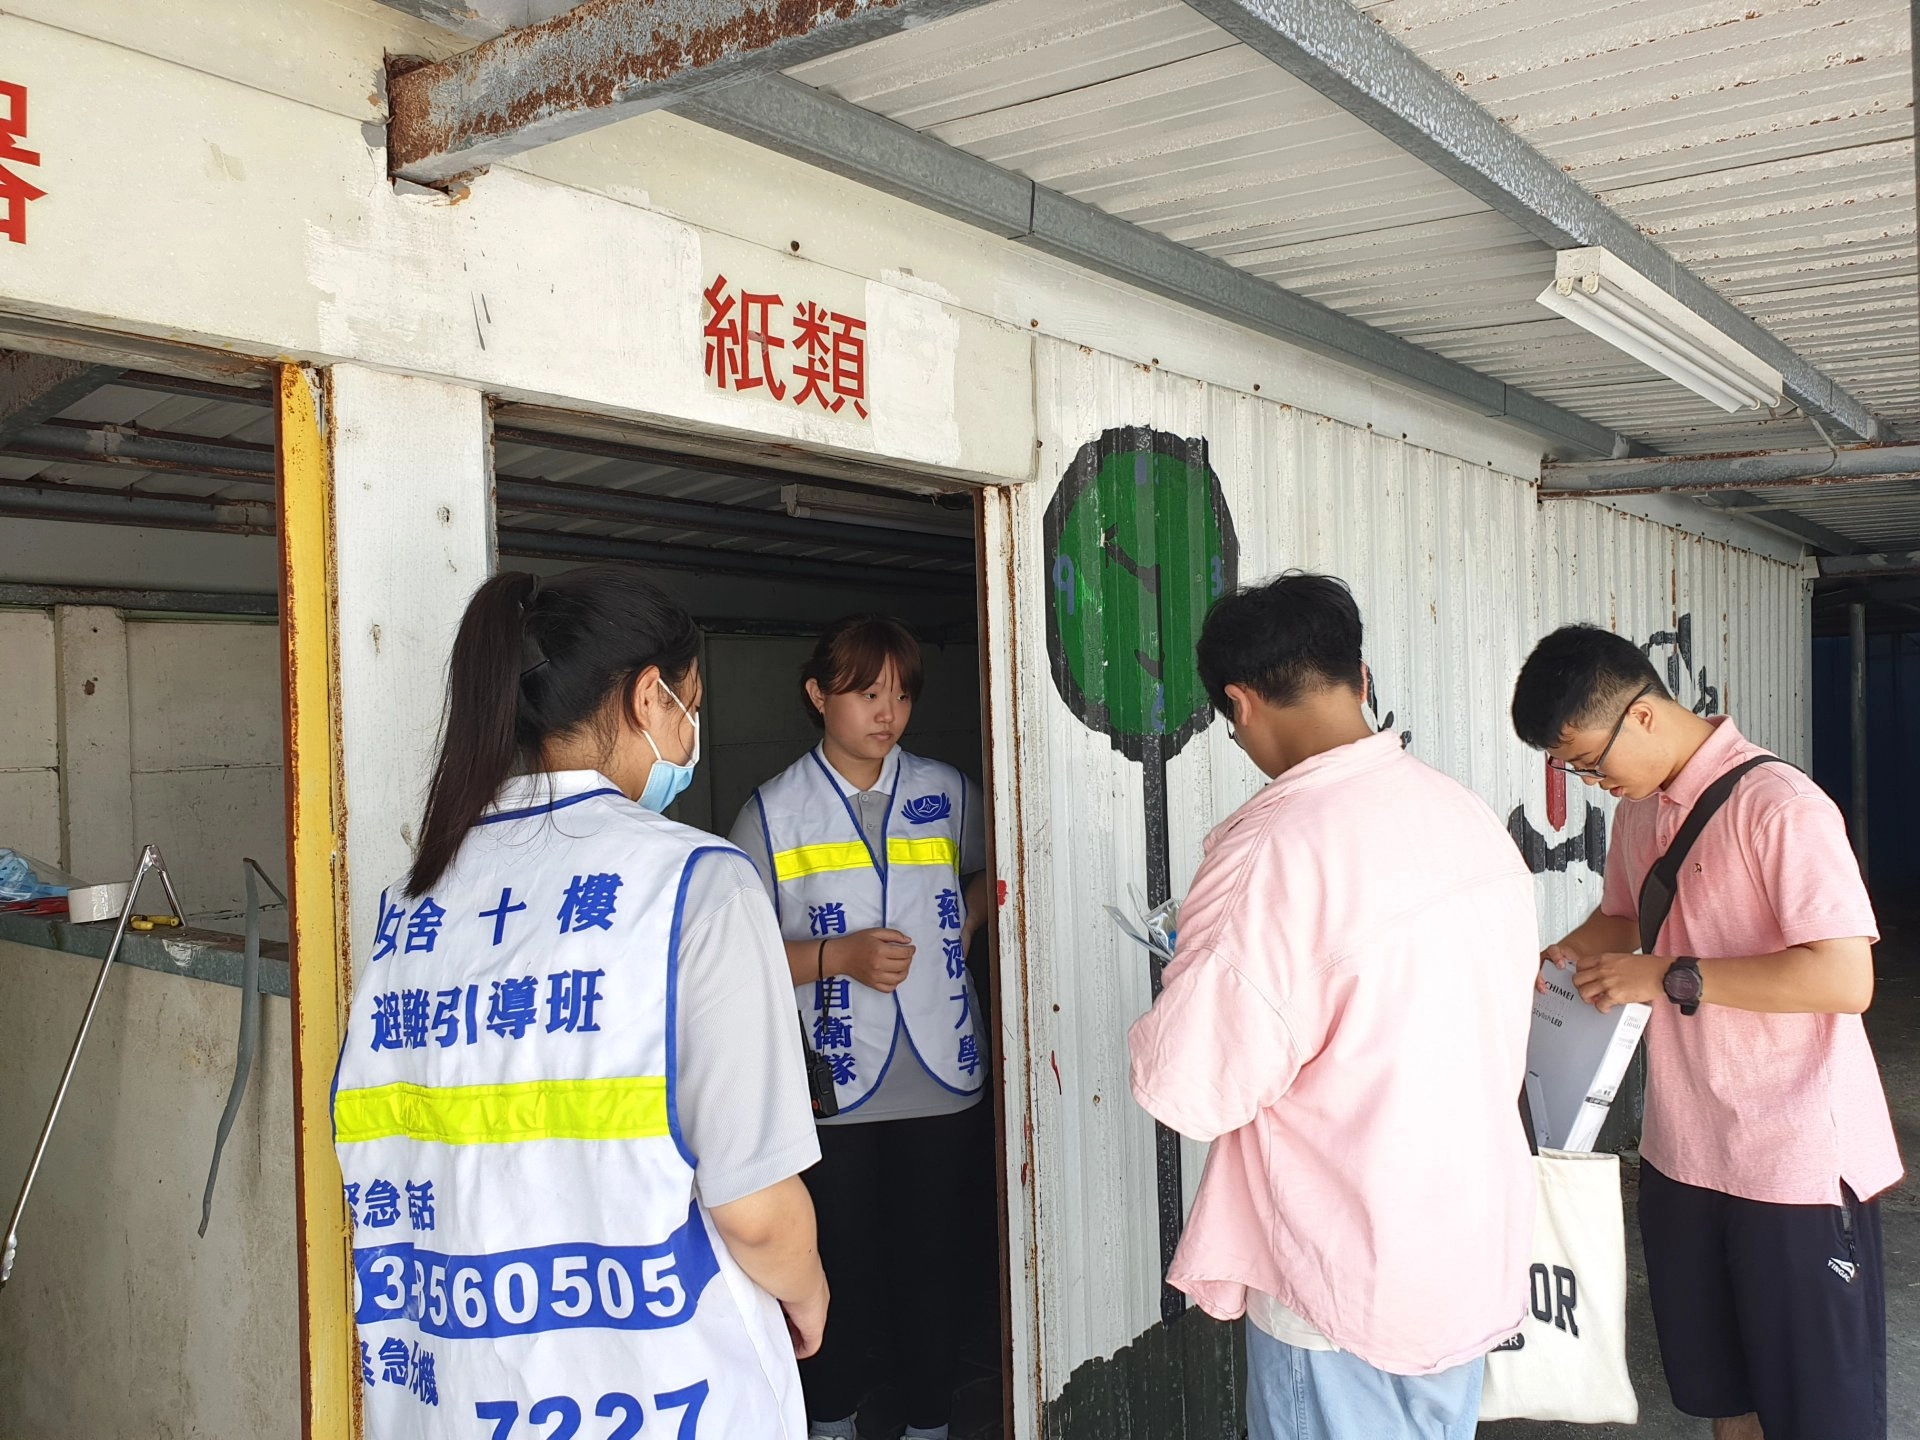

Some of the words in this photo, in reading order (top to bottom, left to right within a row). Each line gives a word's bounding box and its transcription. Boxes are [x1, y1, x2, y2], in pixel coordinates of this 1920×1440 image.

[703, 274, 868, 420] 紙類
[1052, 555, 1075, 616] 9
[1211, 555, 1225, 597] 3
[371, 968, 606, 1052] 避難引導班
[808, 902, 857, 1086] 消自衛隊
[1545, 981, 1575, 1001] CHIMEI
[475, 1379, 710, 1440] 7227
